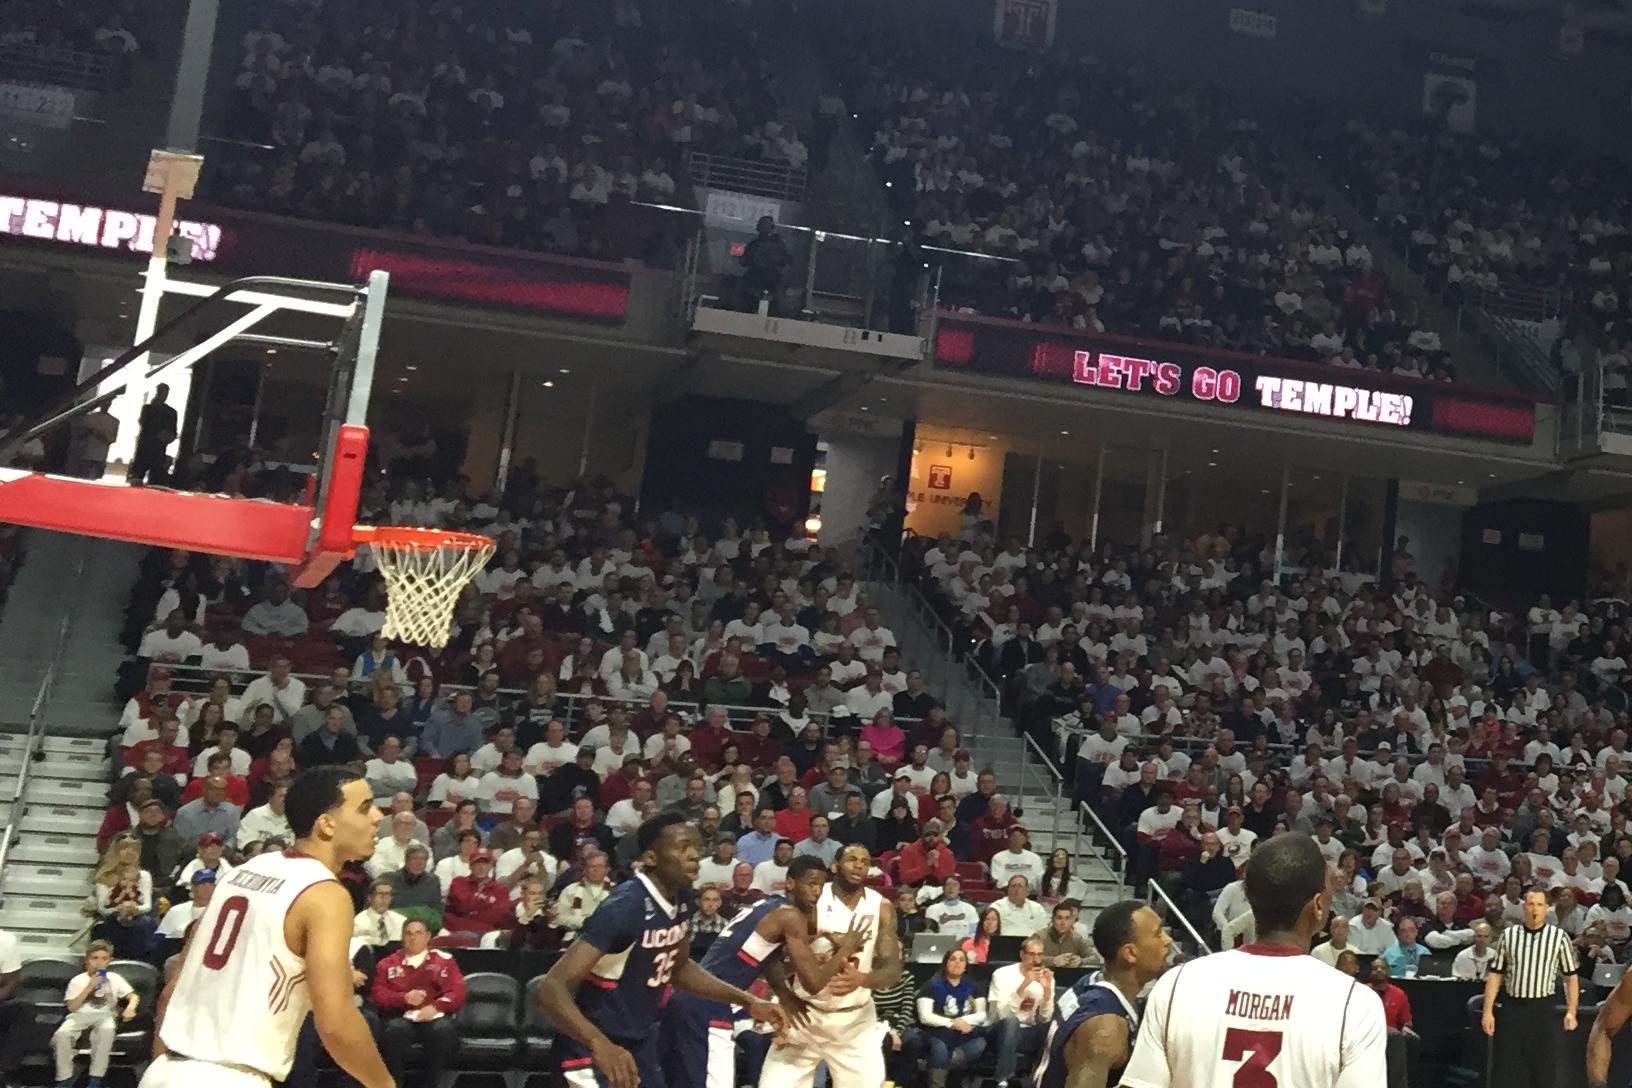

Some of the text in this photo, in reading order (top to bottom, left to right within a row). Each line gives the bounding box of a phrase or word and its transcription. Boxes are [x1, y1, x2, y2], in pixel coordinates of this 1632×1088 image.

[1073, 350, 1413, 426] LET'S GO TEMPLE!
[203, 896, 249, 970] 0
[1225, 988, 1294, 1021] MORGAN
